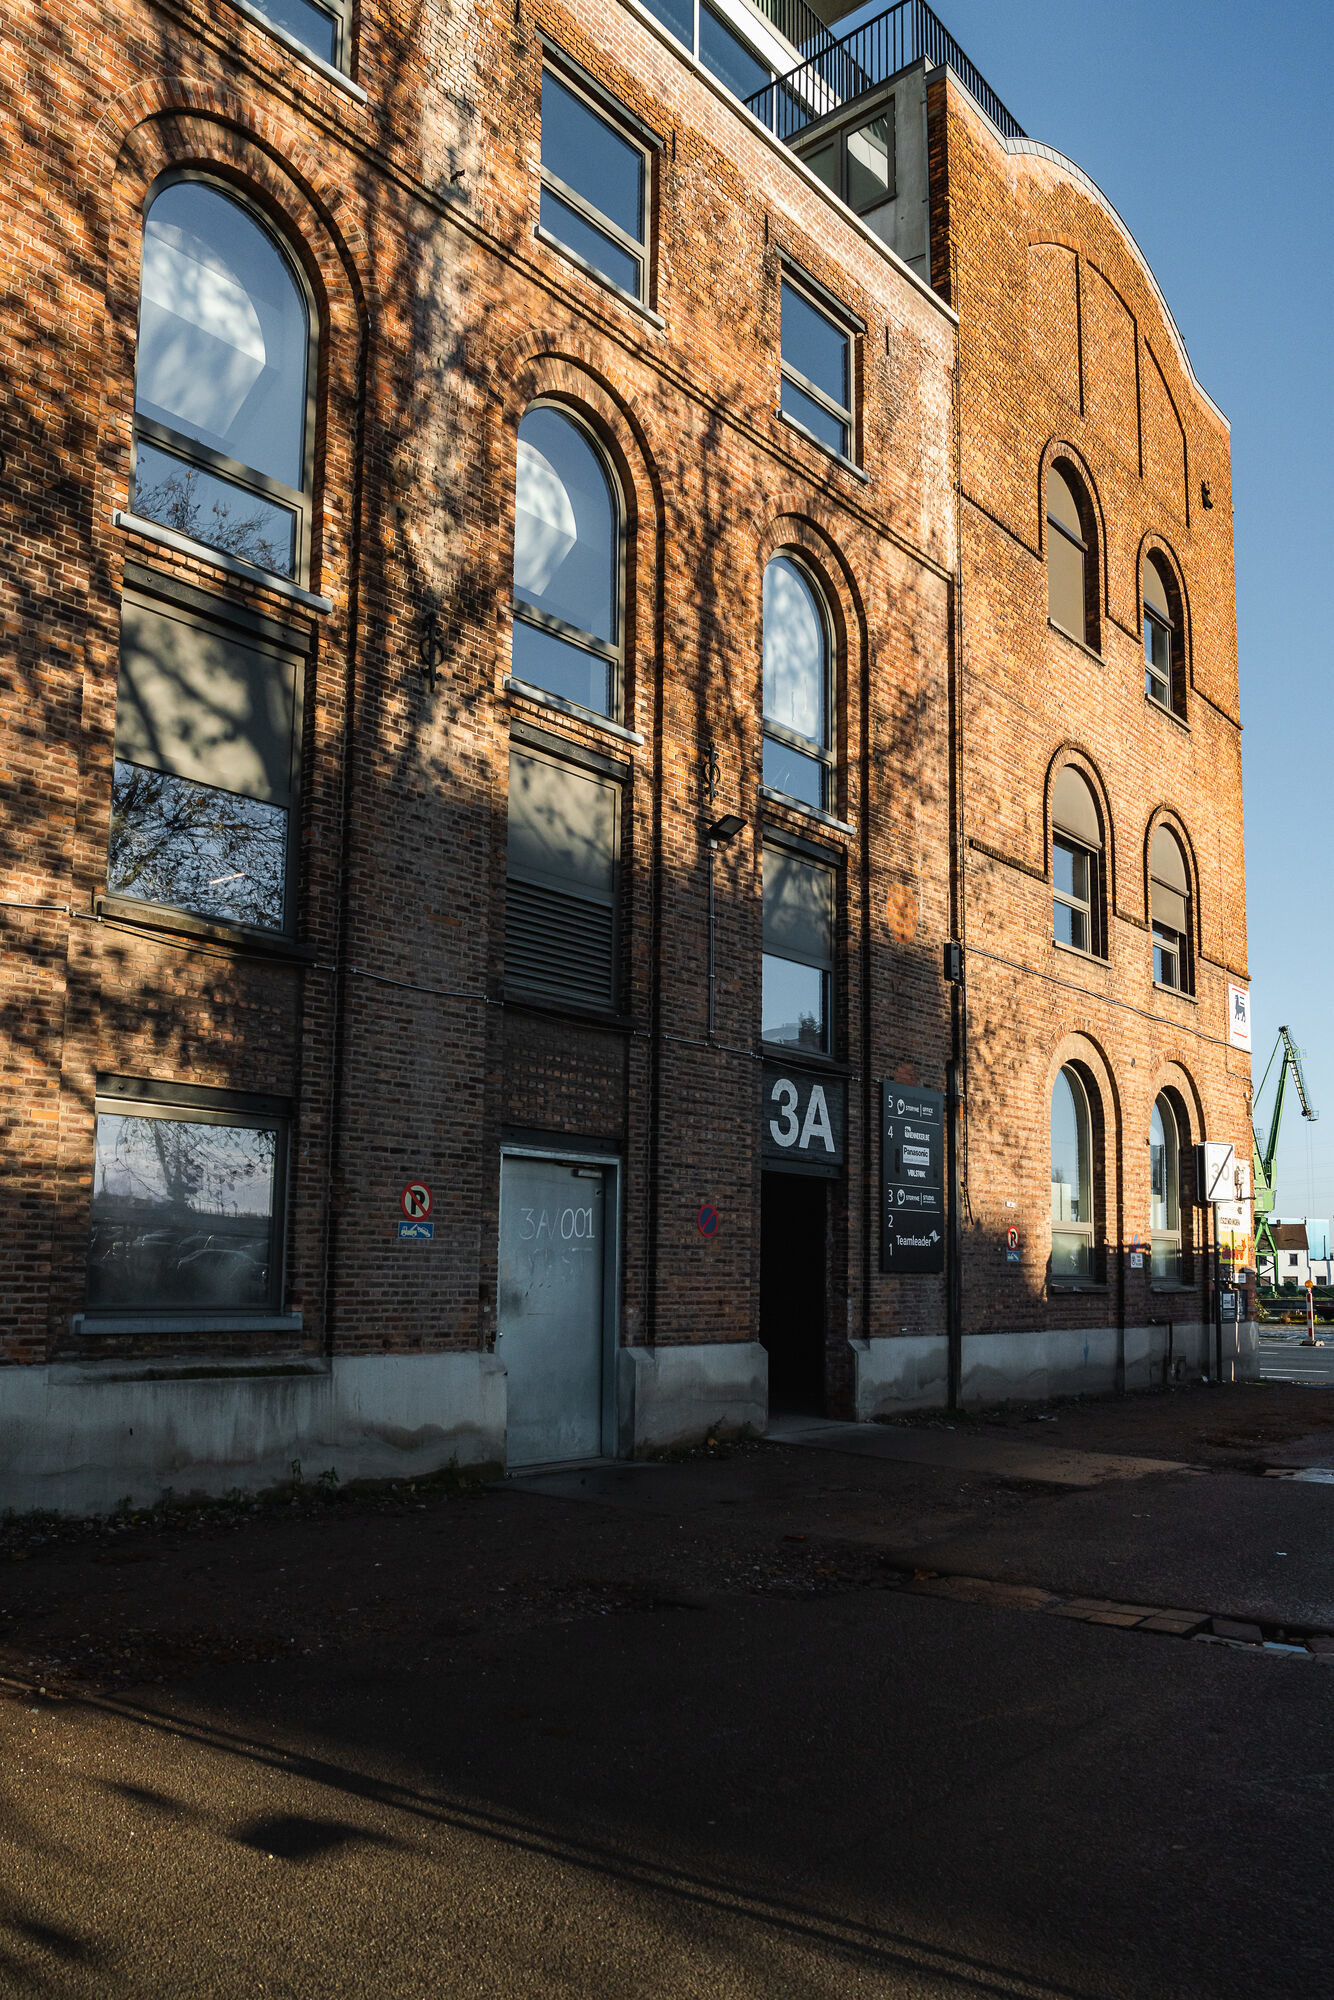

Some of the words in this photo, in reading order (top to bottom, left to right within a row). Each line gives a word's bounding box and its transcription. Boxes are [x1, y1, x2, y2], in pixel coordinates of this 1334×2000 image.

[888, 1095, 894, 1108] 5
[769, 1078, 836, 1153] 3A
[887, 1125, 894, 1138] 4
[903, 1146, 929, 1158] Panasonic
[1211, 1162, 1230, 1181] 30
[410, 1190, 426, 1215] P
[887, 1189, 894, 1203] 3
[519, 1207, 596, 1240] 3A/001
[887, 1214, 894, 1228] 2
[895, 1234, 932, 1247] Teamleader
[1010, 1231, 1017, 1247] P
[888, 1243, 893, 1256] 1
